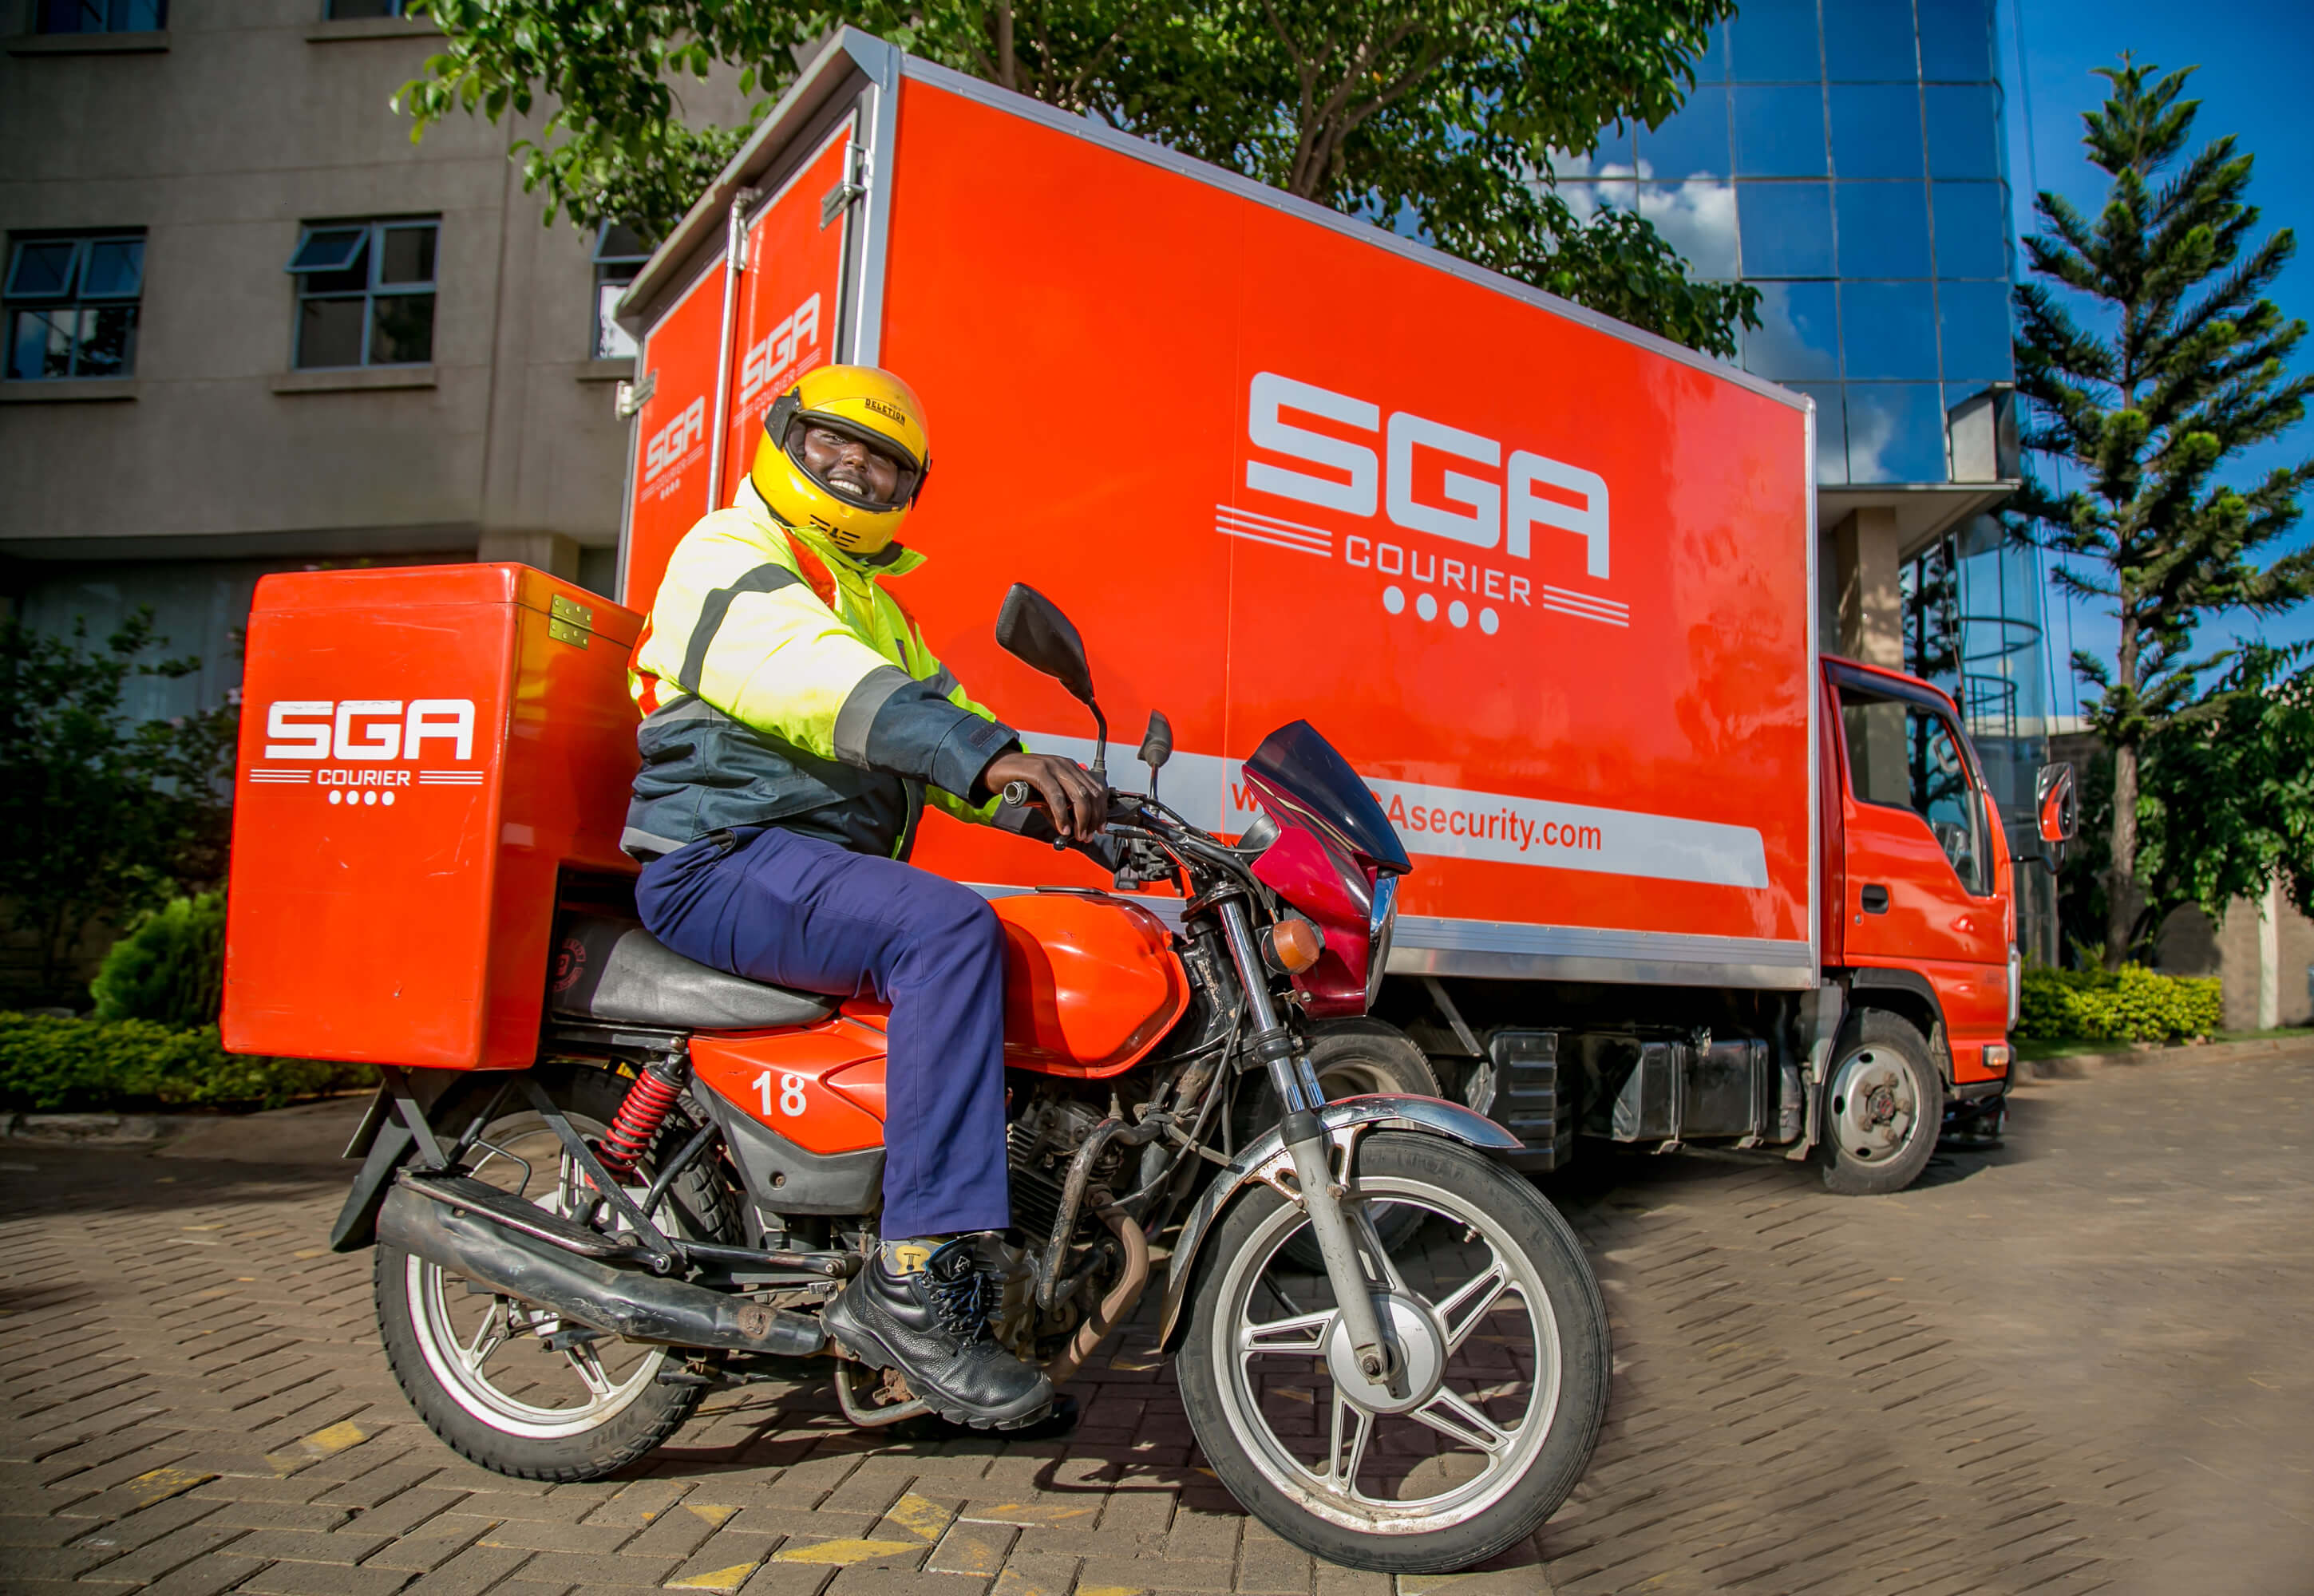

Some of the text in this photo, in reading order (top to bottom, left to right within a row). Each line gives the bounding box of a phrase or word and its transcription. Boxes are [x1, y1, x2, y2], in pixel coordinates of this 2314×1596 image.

[739, 292, 821, 405] SGA
[754, 368, 796, 411] COURIER
[864, 397, 906, 424] DELETION
[644, 395, 705, 483] SGA
[1246, 371, 1610, 580] SGA
[1346, 535, 1531, 606] COURIER
[264, 699, 476, 760] SGA
[316, 768, 411, 787] COURIER
[752, 1070, 807, 1117] 18
